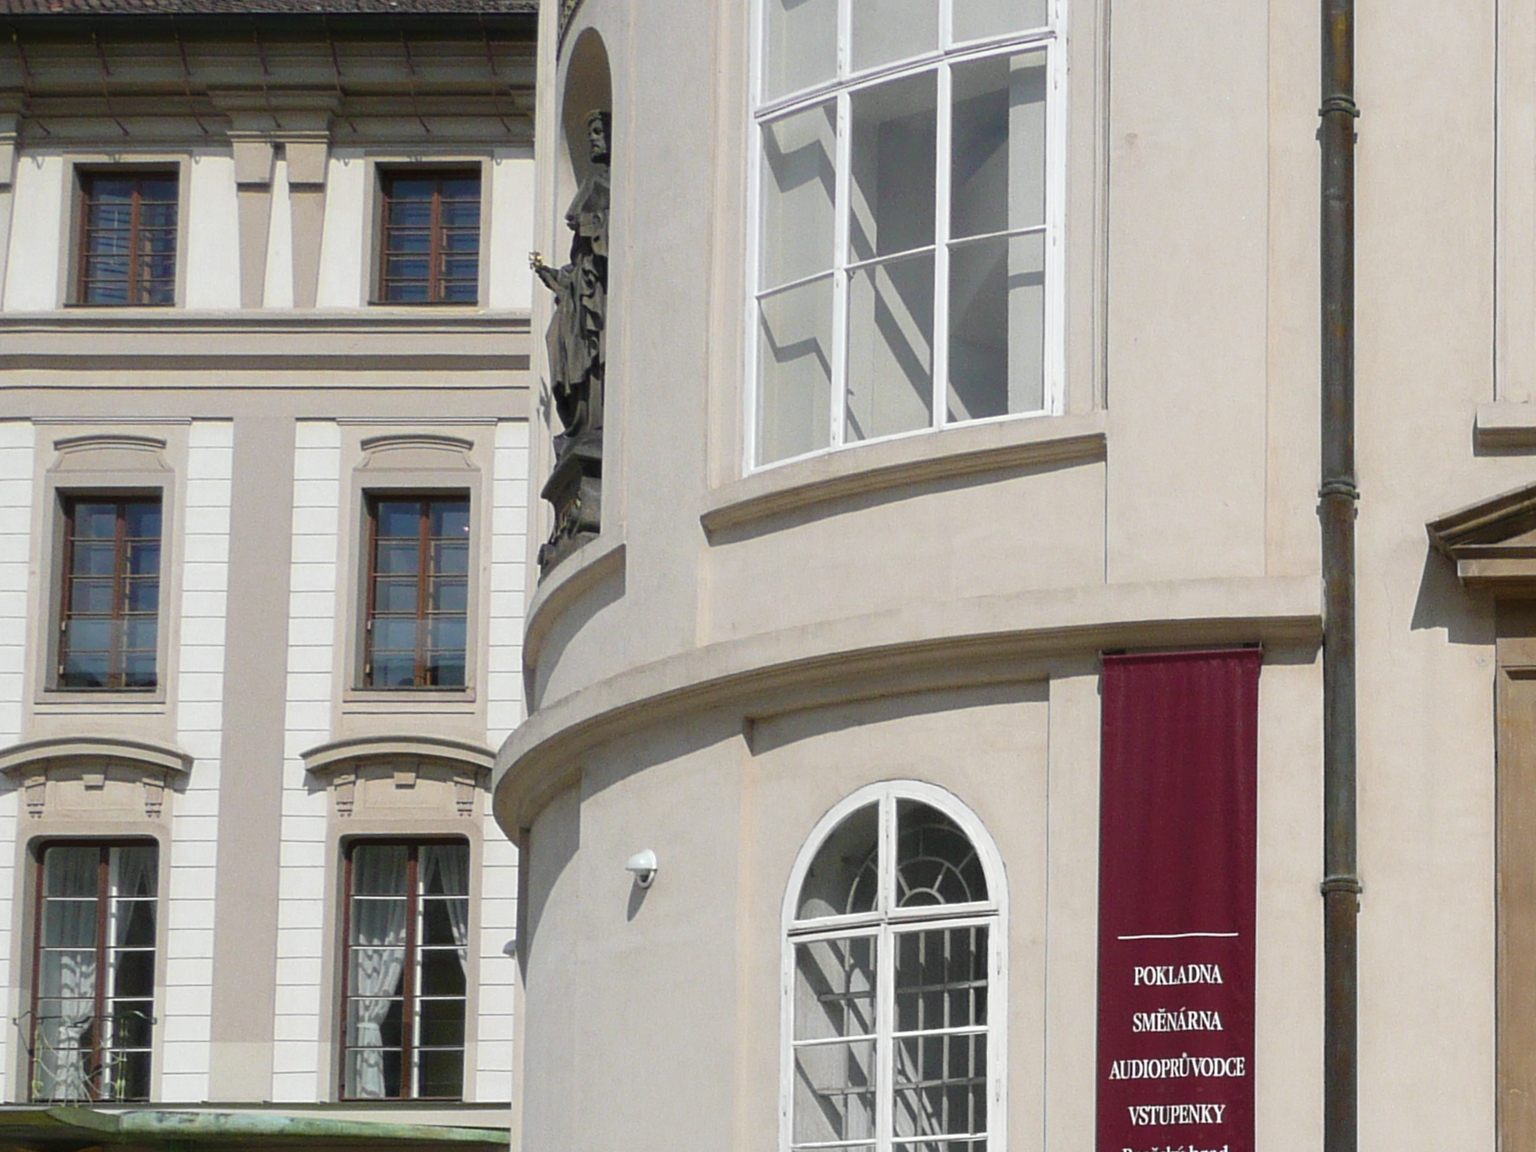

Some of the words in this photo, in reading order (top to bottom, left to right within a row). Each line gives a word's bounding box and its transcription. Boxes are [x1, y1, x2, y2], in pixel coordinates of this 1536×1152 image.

[1133, 964, 1223, 986] POKLADNA
[1132, 1007, 1223, 1033] SMĚNÁRNA
[1108, 1052, 1245, 1080] AUDIOPRŮVODCE
[1128, 1103, 1226, 1126] VSTUPENKY
